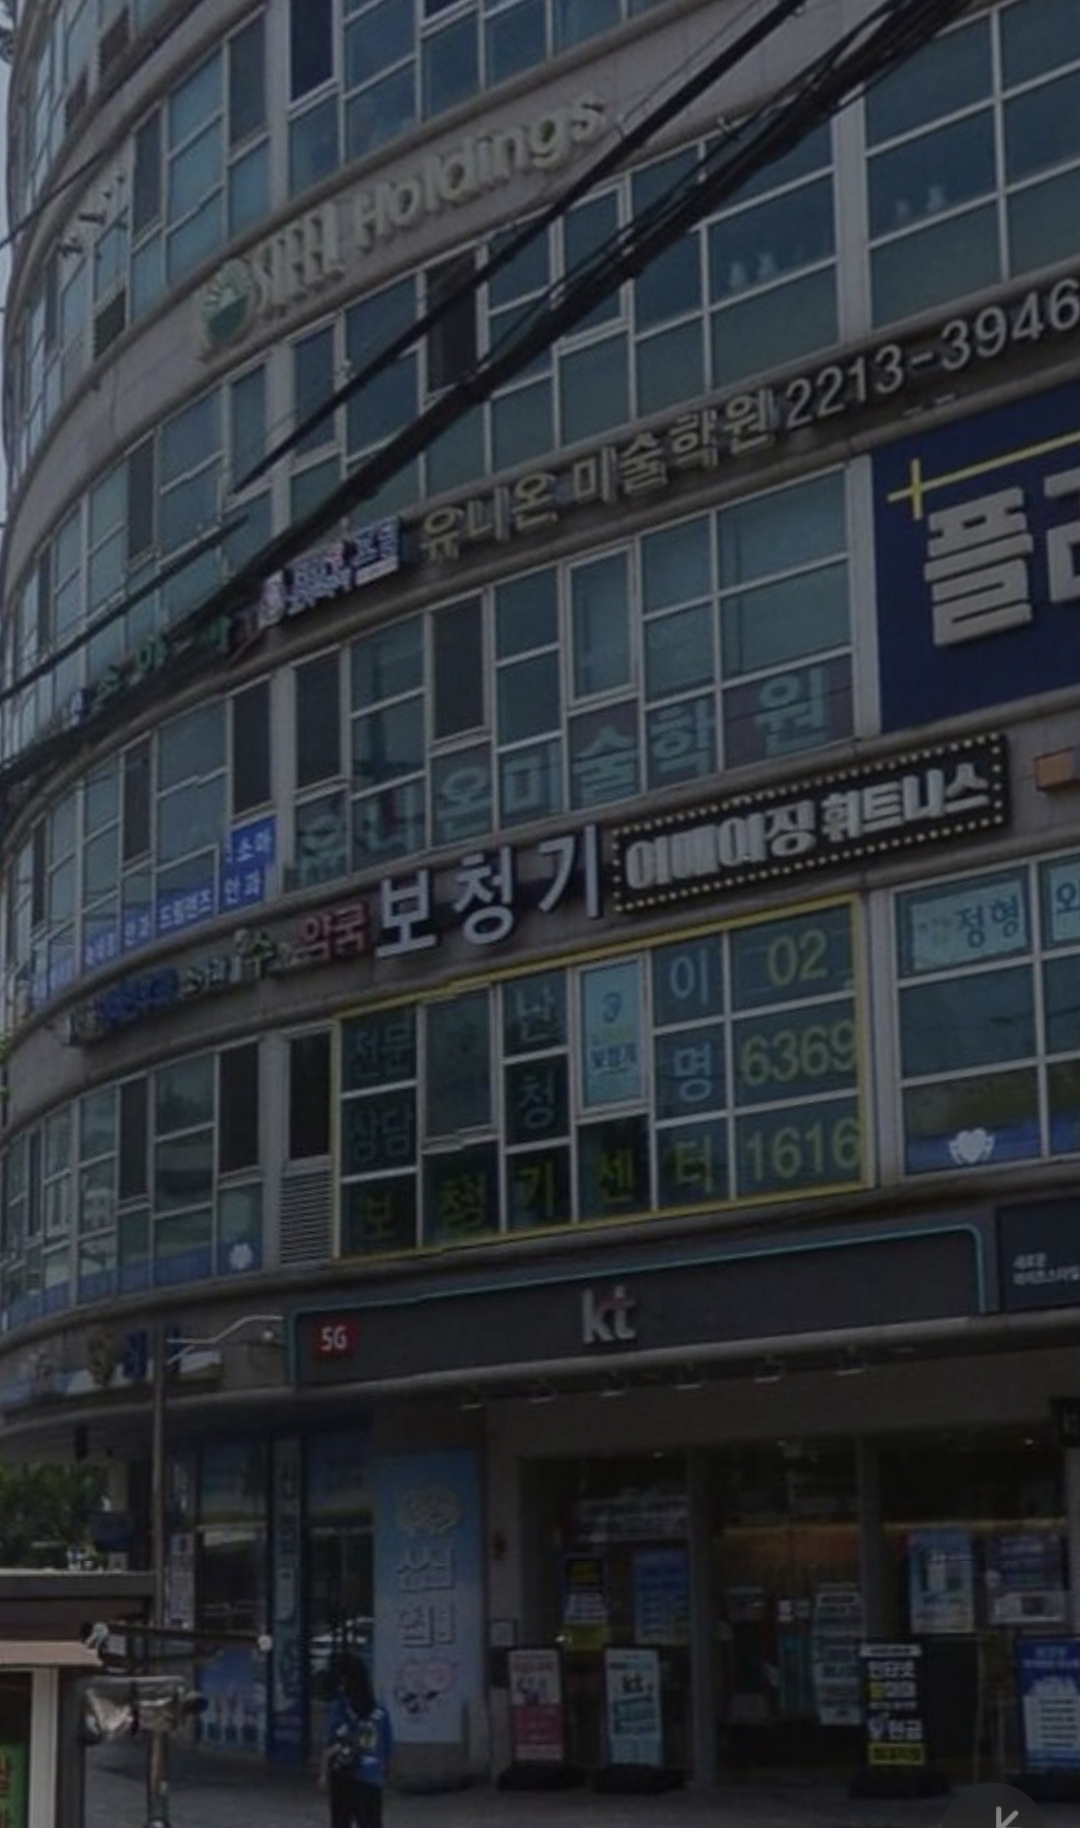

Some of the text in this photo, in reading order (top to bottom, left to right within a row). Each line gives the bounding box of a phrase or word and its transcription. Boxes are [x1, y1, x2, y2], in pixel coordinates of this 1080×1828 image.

[354, 96, 607, 248] Holdings
[421, 470, 557, 560] 유니온
[573, 388, 776, 502] 미술학원
[785, 279, 1080, 429] 2213-3946
[820, 761, 990, 844] 휘트니스
[376, 824, 599, 958] 보청기
[957, 895, 1019, 948] 정형
[767, 929, 828, 987] 02
[741, 1018, 856, 1086] 6369
[746, 1117, 860, 1182] 1616
[320, 1324, 348, 1351] 5G
[582, 1286, 636, 1344] kt
